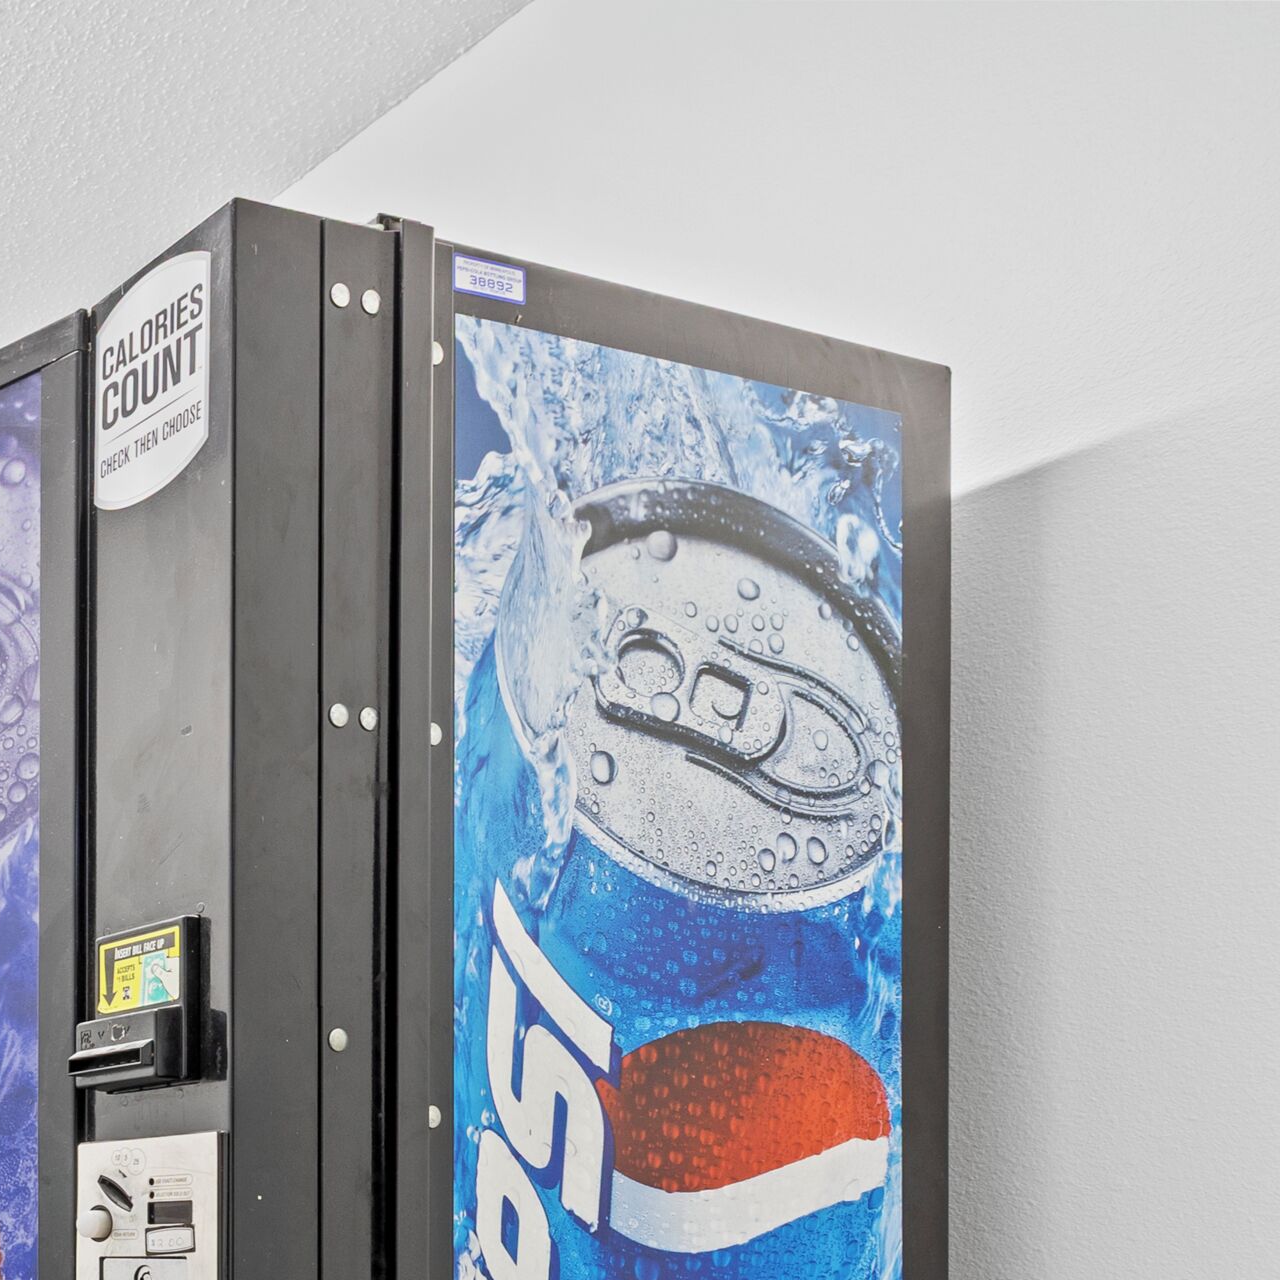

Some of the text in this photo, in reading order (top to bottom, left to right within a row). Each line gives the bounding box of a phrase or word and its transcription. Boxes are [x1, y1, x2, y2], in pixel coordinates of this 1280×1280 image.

[470, 274, 513, 293] 38892
[102, 283, 203, 380] CALORIES
[101, 322, 203, 431] COUNT
[100, 400, 202, 479] CHECK THEN CHOOSE
[114, 938, 165, 960] INSERT BILL FACE UP
[117, 964, 135, 974] ACCEPTS
[121, 973, 135, 982] BILLS
